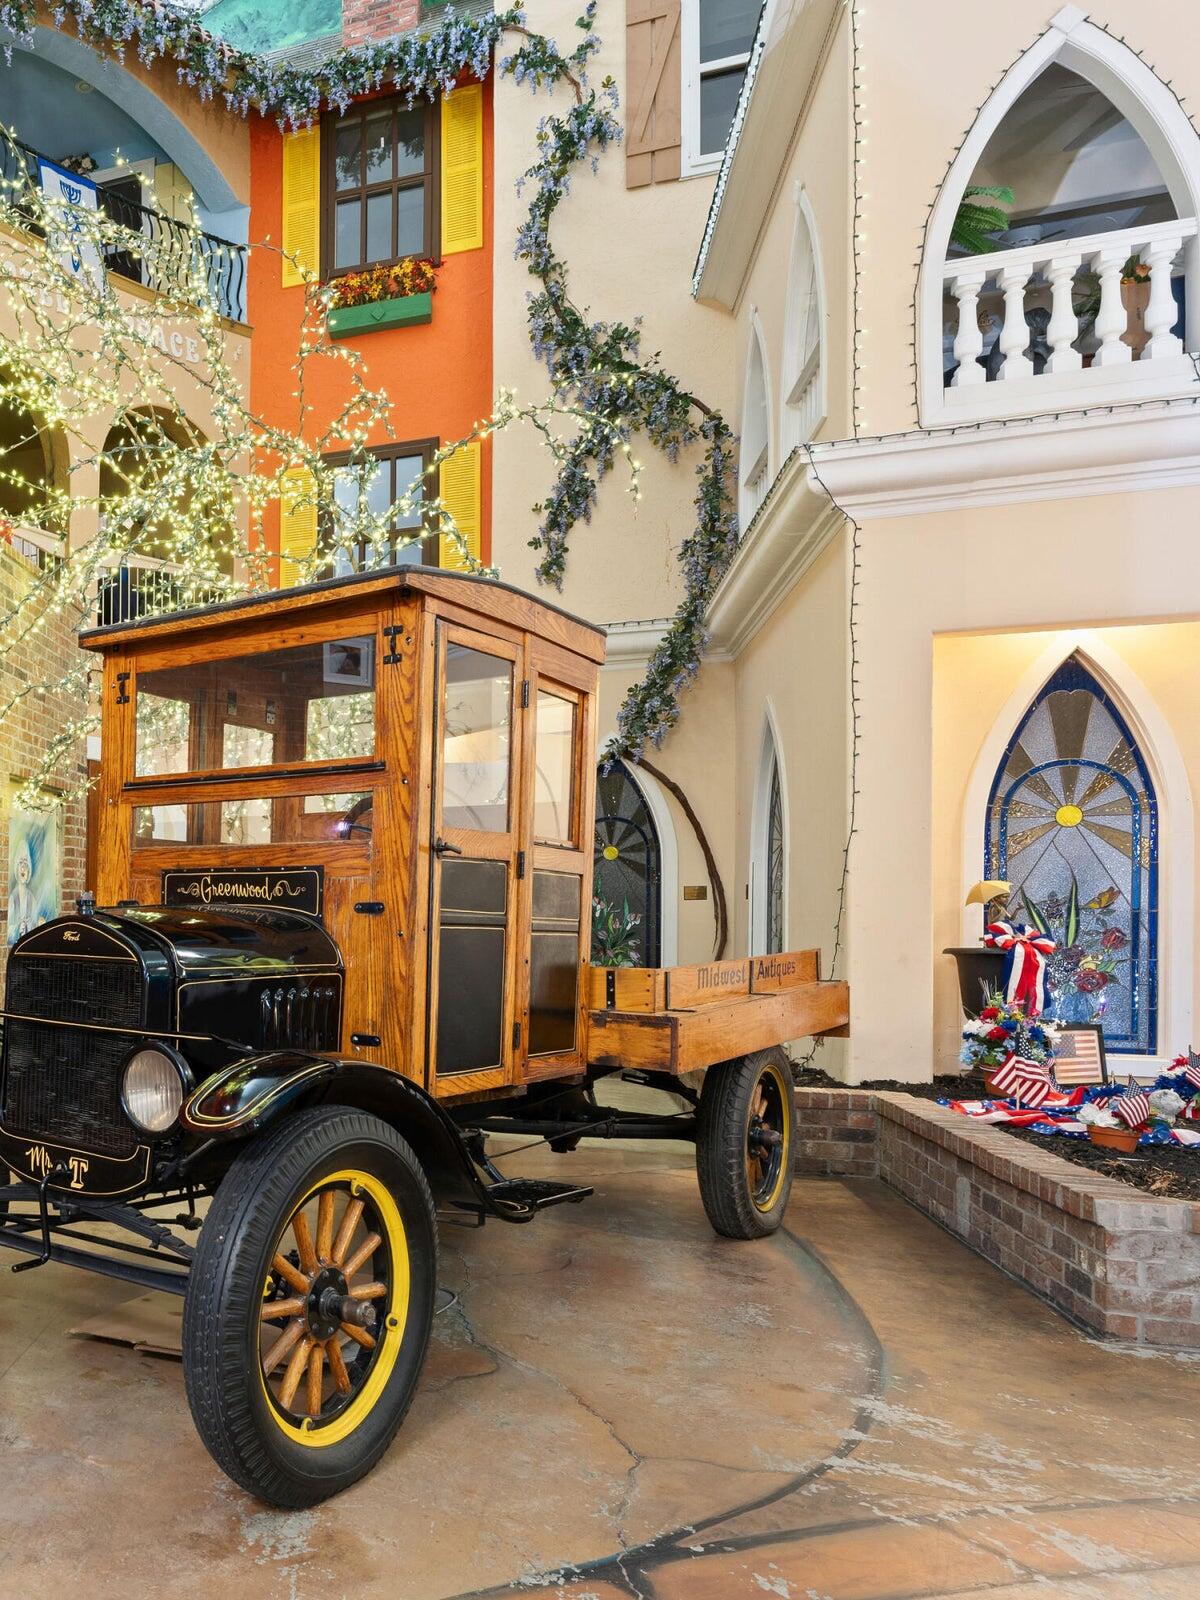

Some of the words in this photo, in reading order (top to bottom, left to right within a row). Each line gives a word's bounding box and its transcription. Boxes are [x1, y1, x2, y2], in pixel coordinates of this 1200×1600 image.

[201, 875, 273, 903] Greenwood
[62, 930, 81, 941] Ford
[697, 964, 747, 990] Midwest
[756, 958, 796, 986] Antiques
[68, 1156, 89, 1190] T
